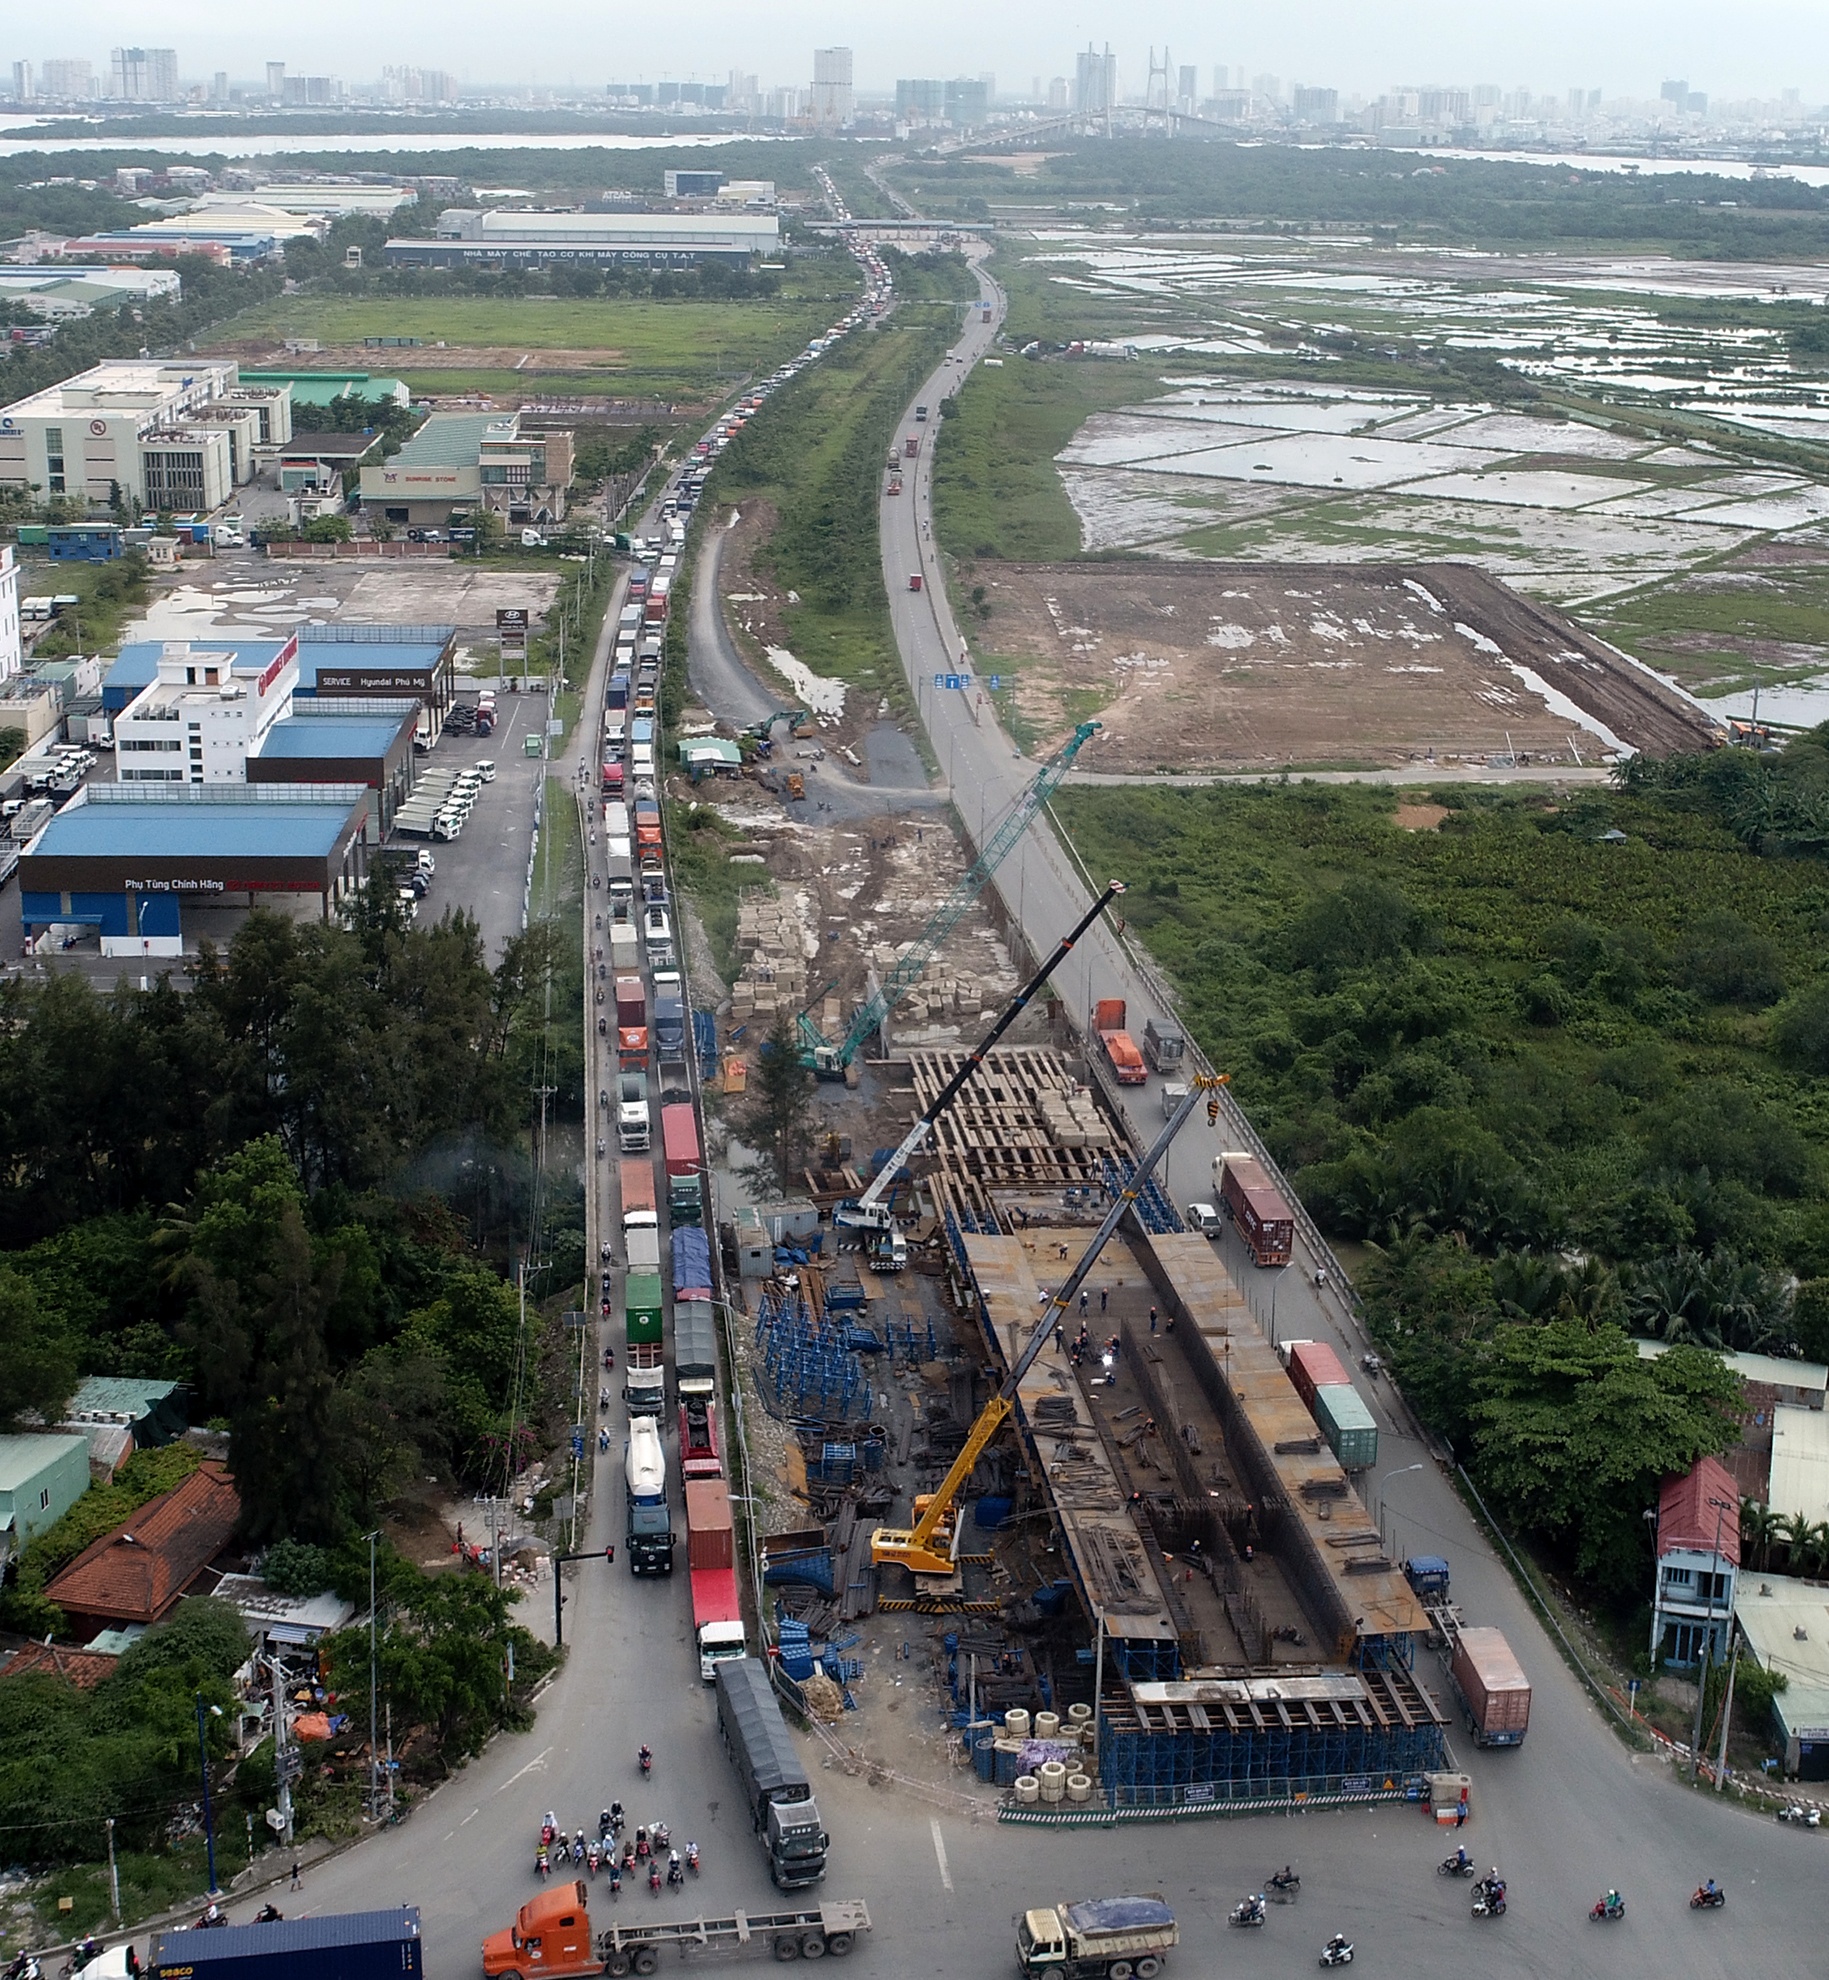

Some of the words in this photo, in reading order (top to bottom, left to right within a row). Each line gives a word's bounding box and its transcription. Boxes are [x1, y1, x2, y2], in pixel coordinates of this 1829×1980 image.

[598, 250, 617, 258] MÁY
[322, 678, 351, 686] SERVICE
[360, 678, 391, 687] Hyundai
[413, 678, 425, 687] Mỹ
[125, 880, 143, 890] Phụ
[146, 880, 170, 890] Tùng
[172, 880, 198, 888] Chính
[200, 880, 224, 890] Hãng
